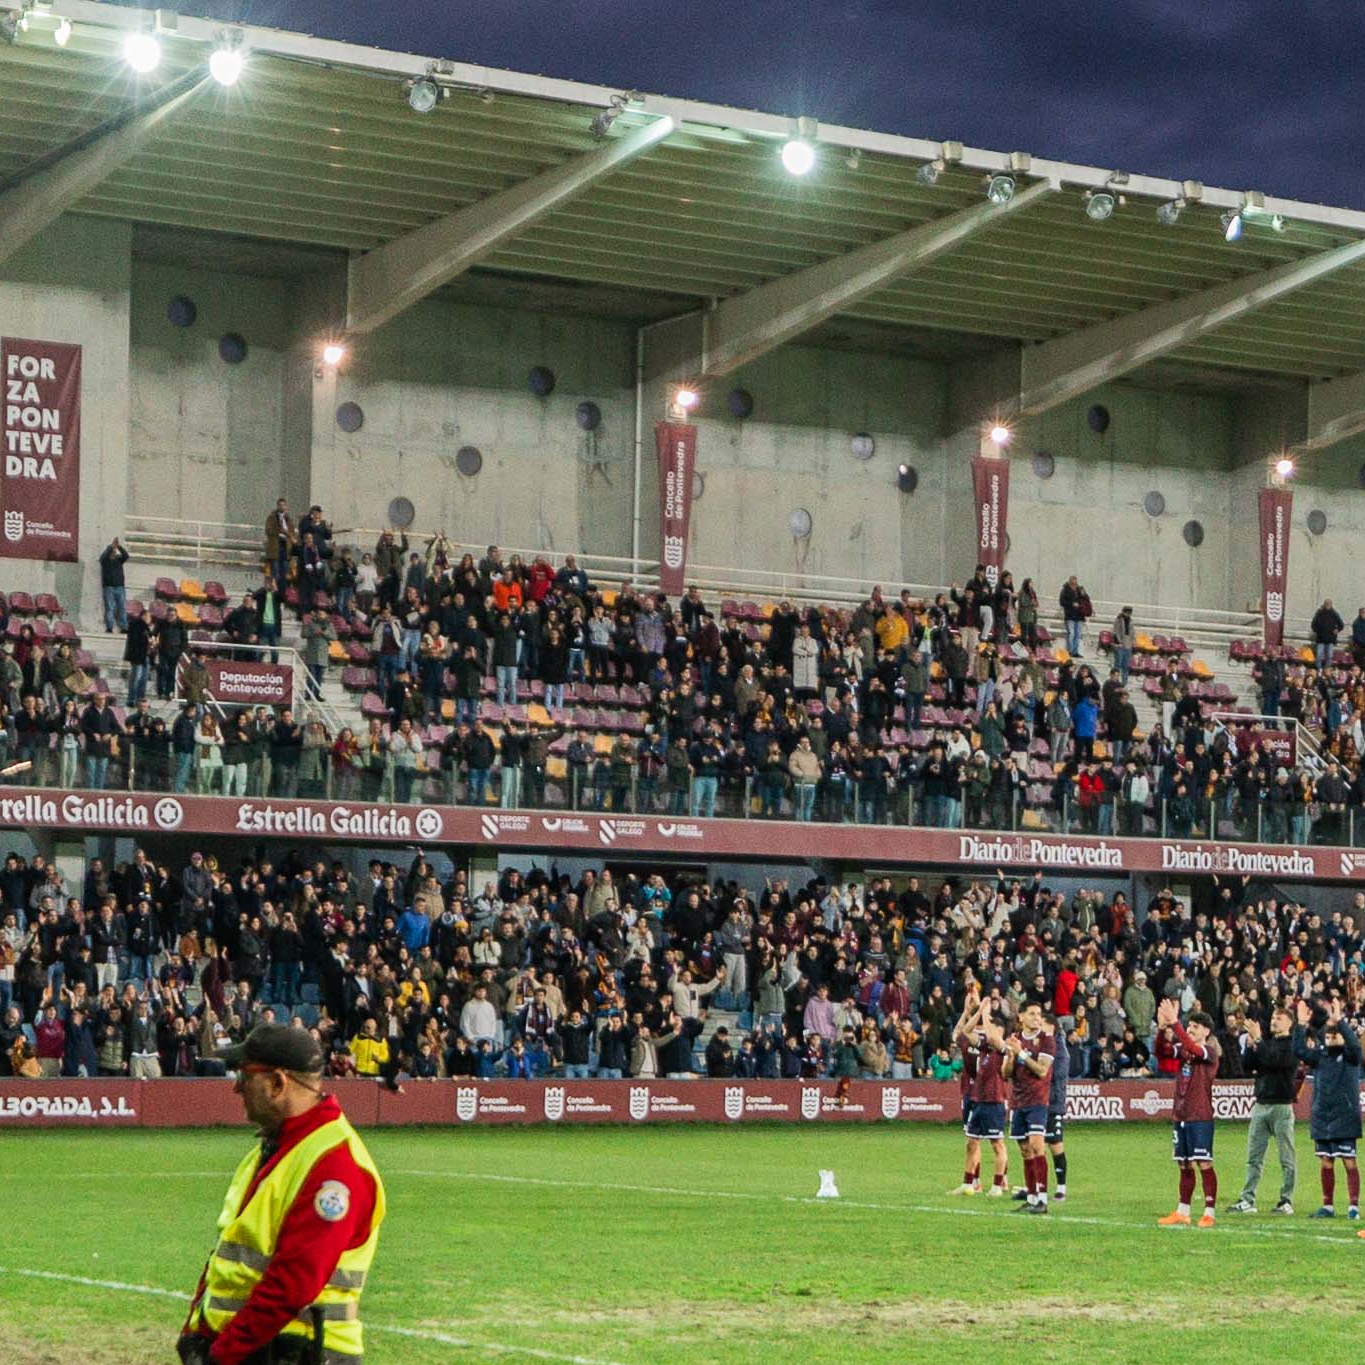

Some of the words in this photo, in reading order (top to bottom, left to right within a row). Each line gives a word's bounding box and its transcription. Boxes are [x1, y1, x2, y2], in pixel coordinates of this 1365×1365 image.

[7, 354, 56, 380] FOR
[6, 380, 40, 402] ZA
[6, 405, 60, 430] PON
[5, 430, 63, 455] TEVE
[5, 455, 57, 480] DRA
[675, 441, 685, 504] Pontevedra
[666, 471, 675, 518] Concello
[991, 474, 999, 534] Pontevedra
[675, 506, 683, 519] de
[981, 502, 990, 548] Concello
[991, 537, 998, 549] de
[1275, 506, 1283, 562] Pontevedra
[1275, 565, 1282, 576] de
[219, 671, 283, 685] Deputación
[219, 682, 283, 695] Pontevedra
[62, 795, 149, 826] Galicia
[235, 803, 327, 833] Estrella
[330, 806, 411, 837] Galicia
